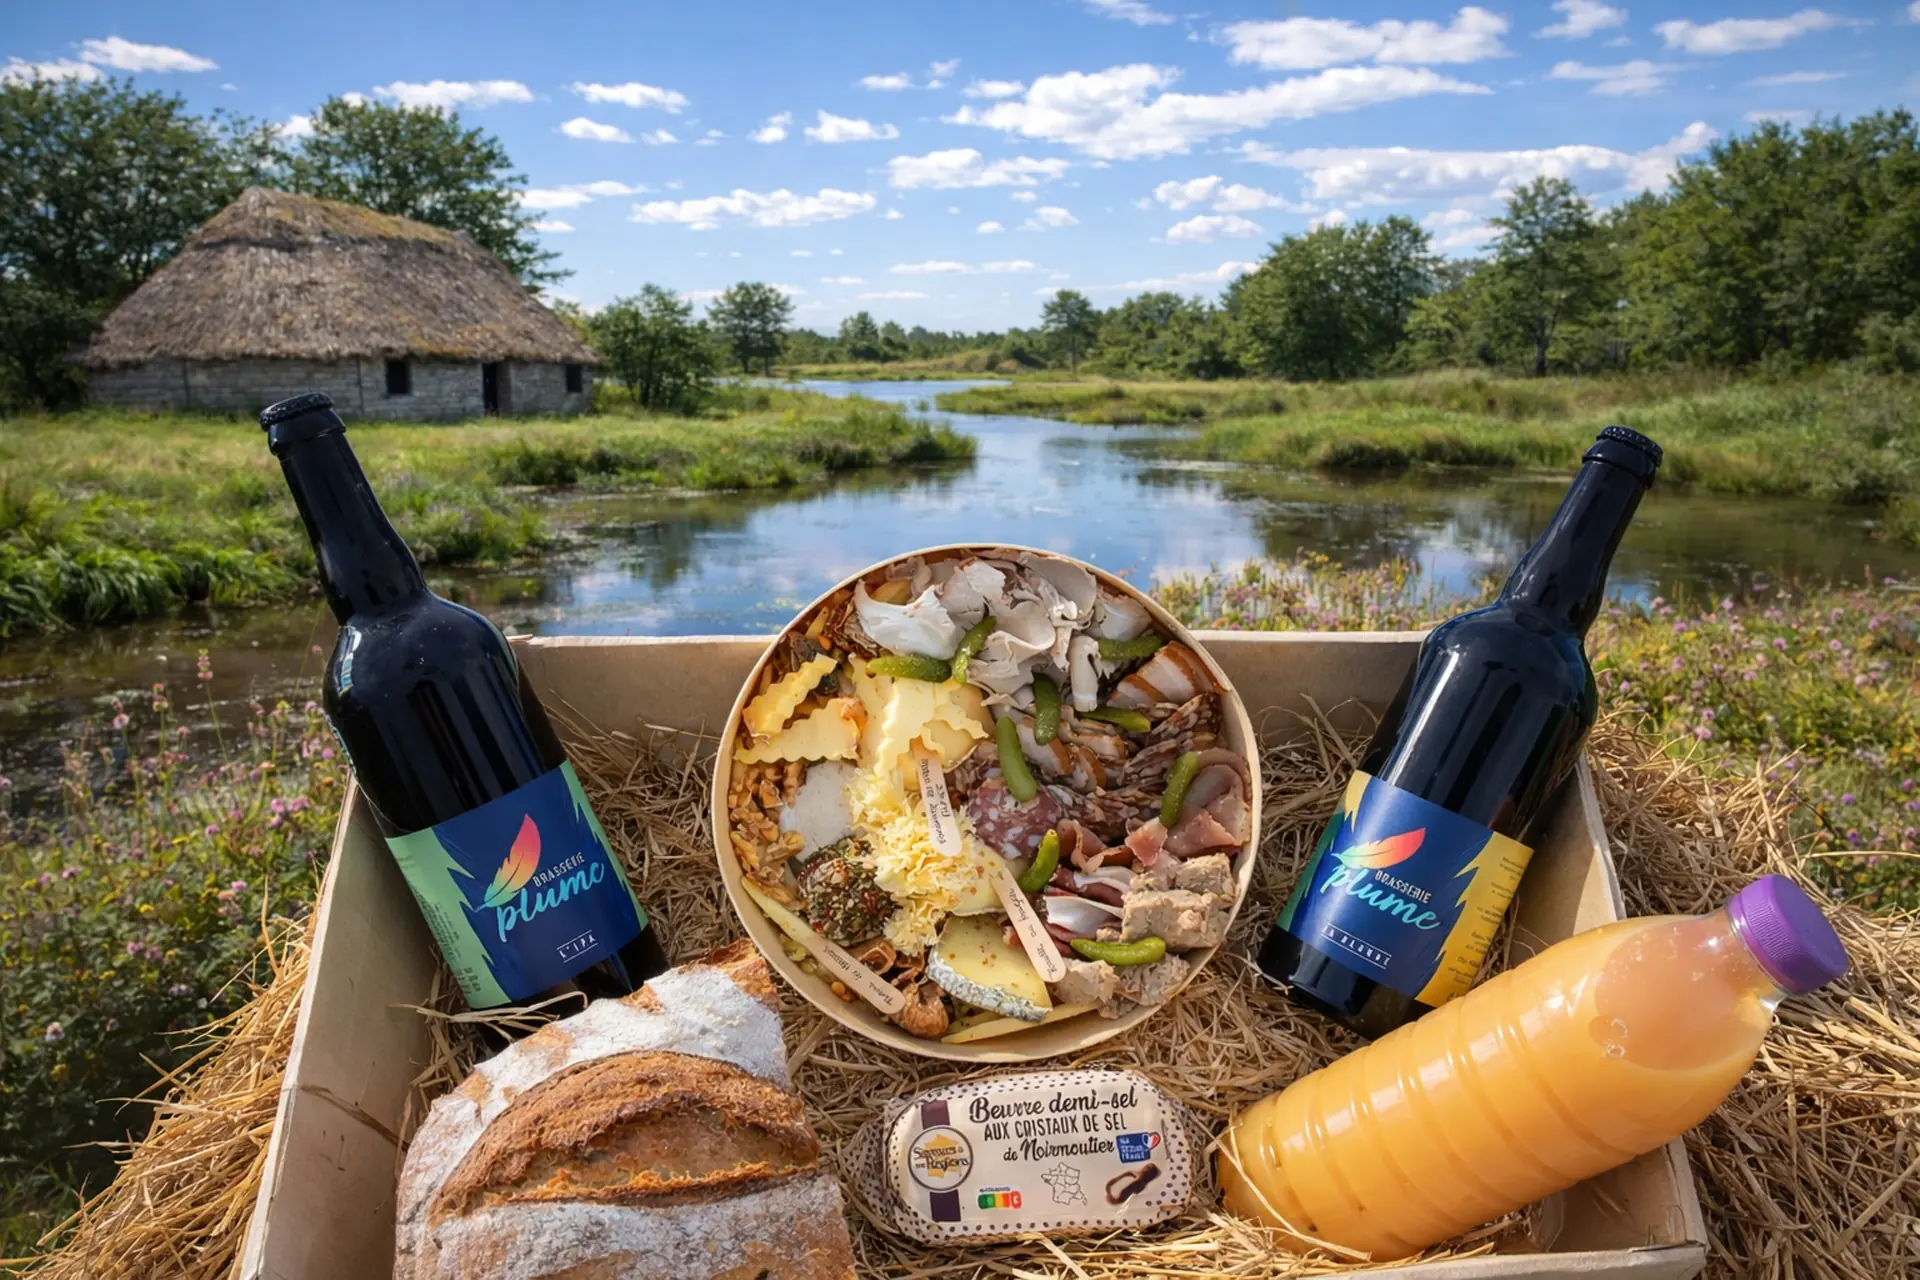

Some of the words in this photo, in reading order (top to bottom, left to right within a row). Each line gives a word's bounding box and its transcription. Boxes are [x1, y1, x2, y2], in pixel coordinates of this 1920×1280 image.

[1320, 863, 1440, 930] plume
[969, 1096, 1044, 1123] Beurre
[1049, 1085, 1138, 1113] demi-sel
[984, 1122, 1010, 1141] AUX
[1082, 1114, 1100, 1132] DE
[1104, 1112, 1127, 1131] SEL
